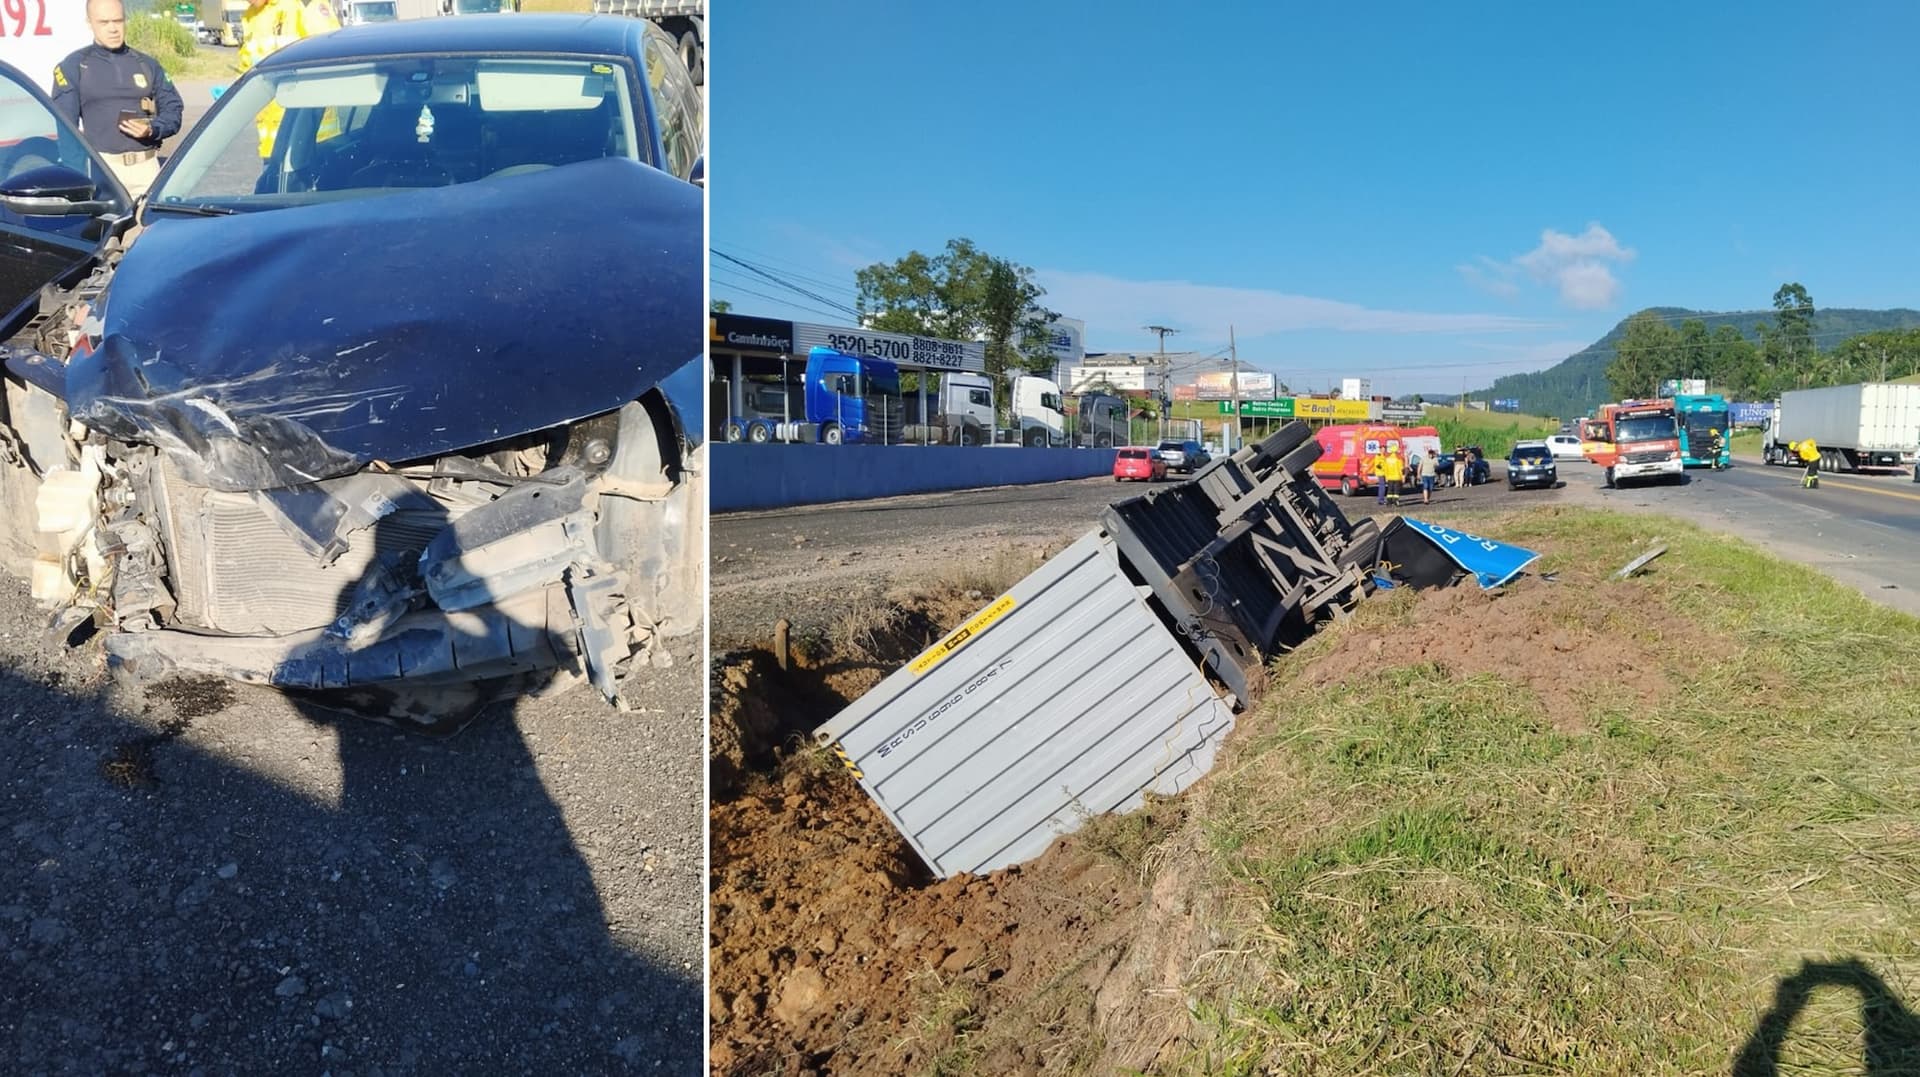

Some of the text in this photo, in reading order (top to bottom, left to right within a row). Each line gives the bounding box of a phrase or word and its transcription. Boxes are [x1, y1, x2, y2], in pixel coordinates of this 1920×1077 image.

[0, 0, 53, 37] 92
[827, 334, 910, 359] 3520-5700
[877, 659, 1013, 758] MRSU 696 684 7
